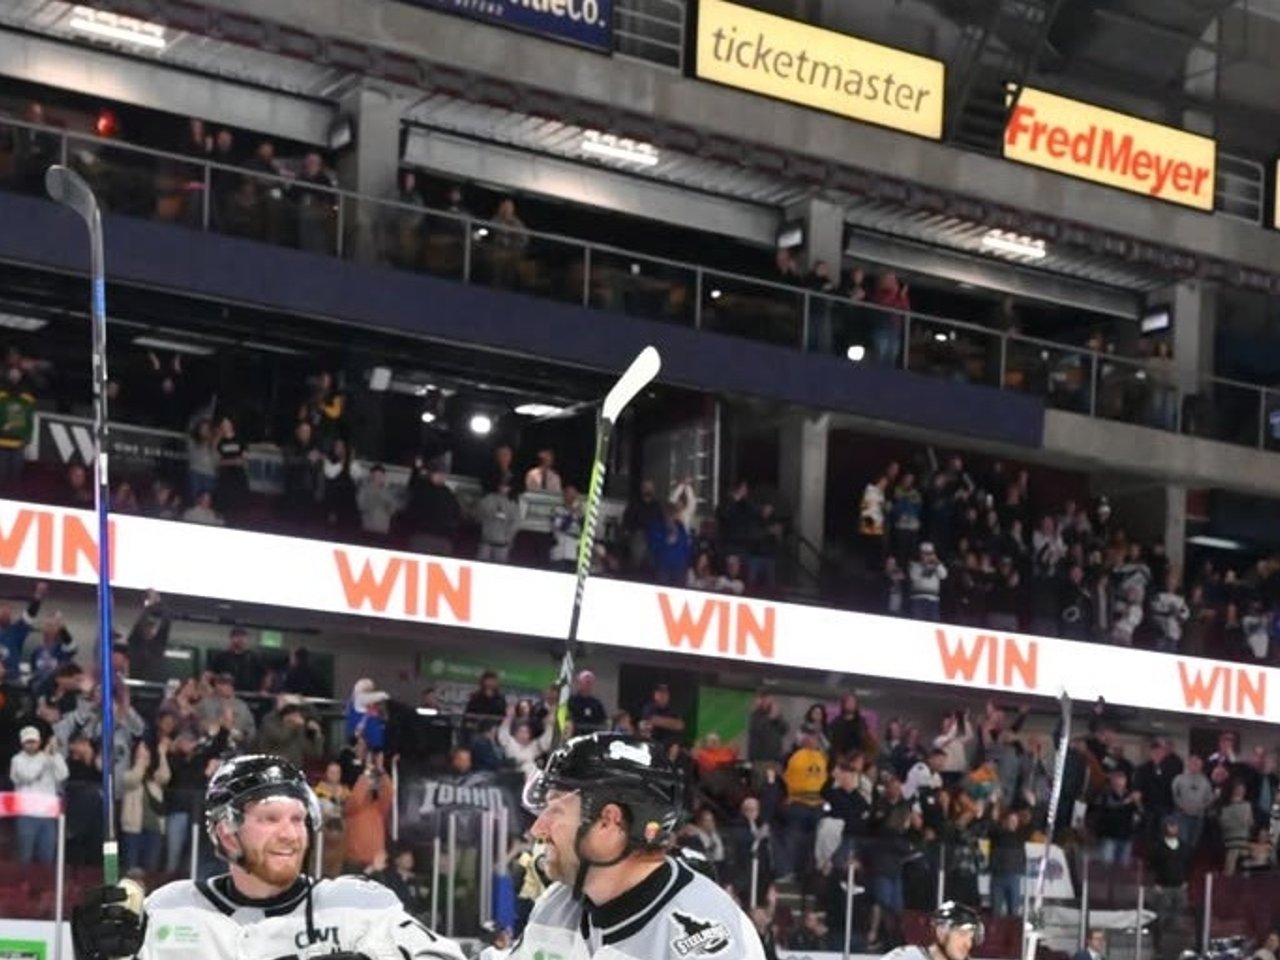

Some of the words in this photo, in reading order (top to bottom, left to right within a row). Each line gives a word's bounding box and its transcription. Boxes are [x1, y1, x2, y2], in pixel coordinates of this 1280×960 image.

[712, 27, 931, 113] ticketmaster
[334, 550, 472, 622] WIN
[658, 593, 775, 658] WIN
[935, 630, 1038, 689] WIN
[1178, 662, 1267, 716] WIN
[419, 780, 505, 814] IDAHO
